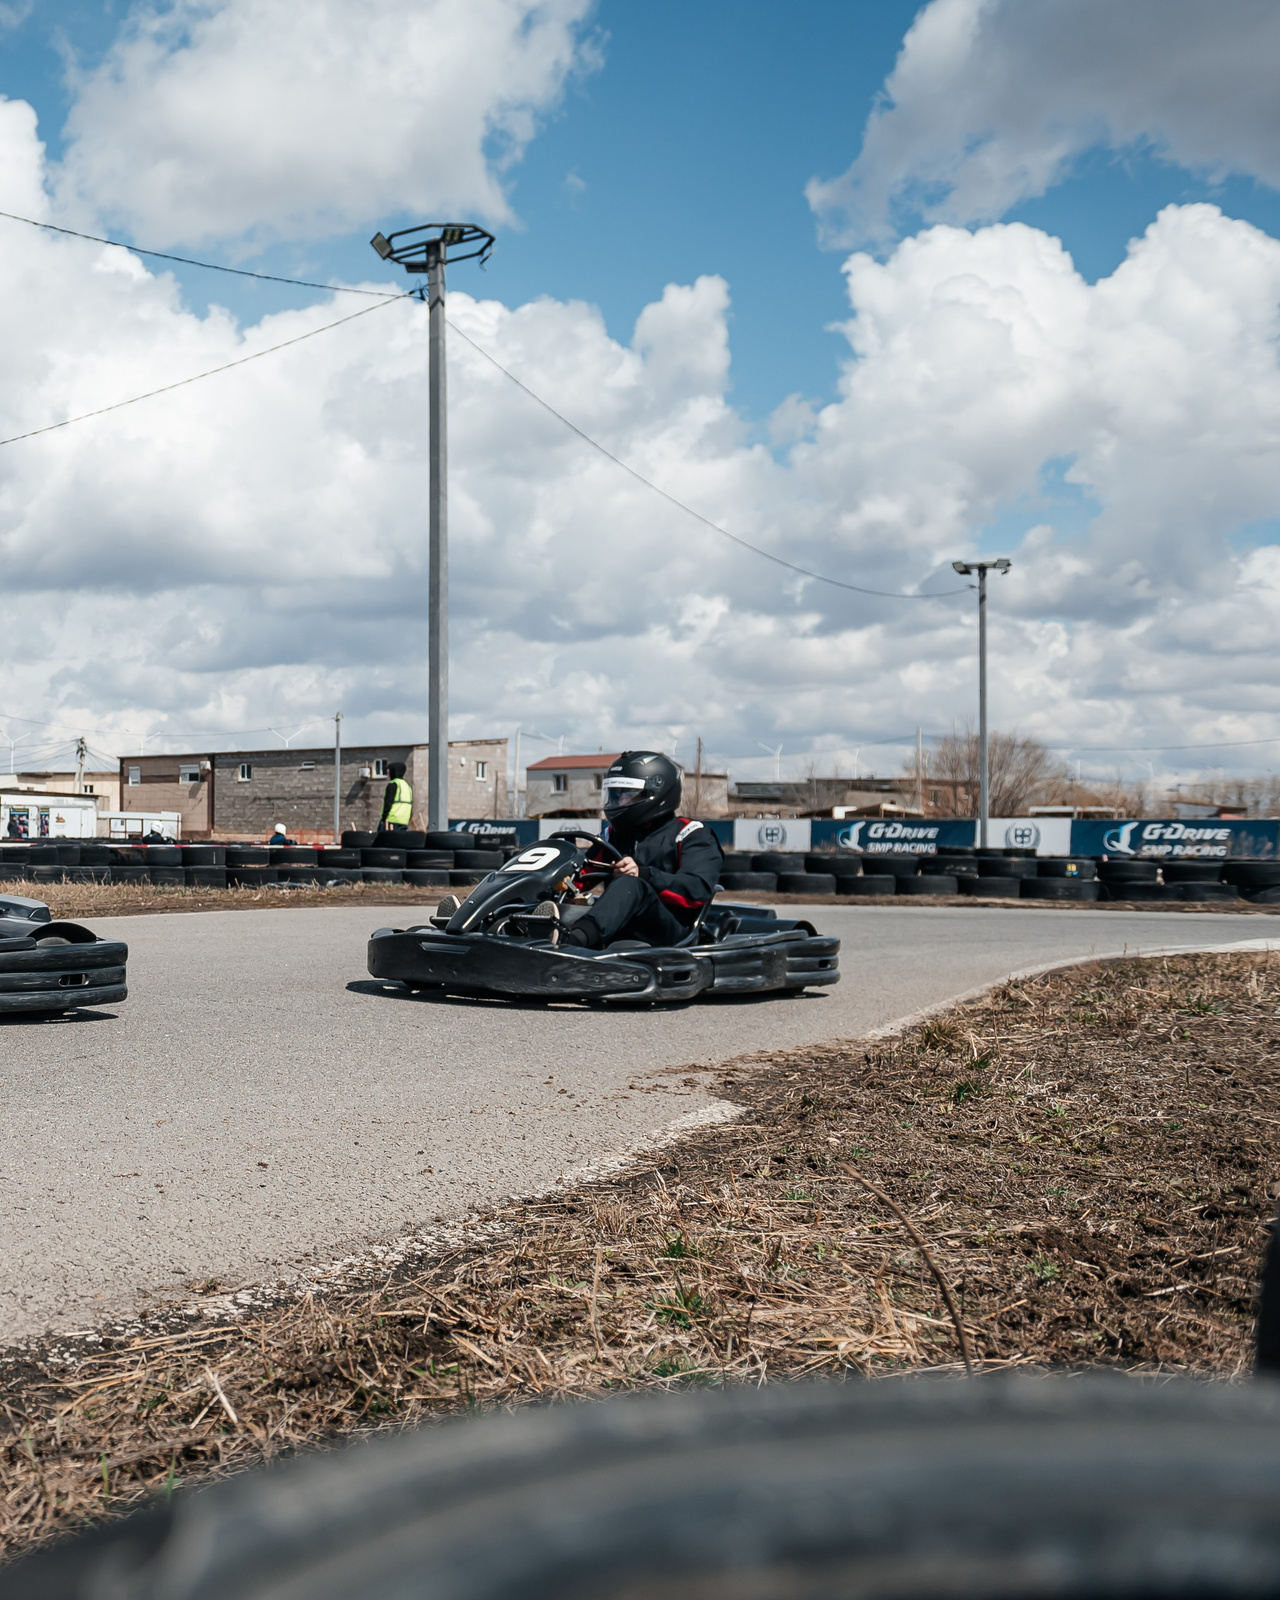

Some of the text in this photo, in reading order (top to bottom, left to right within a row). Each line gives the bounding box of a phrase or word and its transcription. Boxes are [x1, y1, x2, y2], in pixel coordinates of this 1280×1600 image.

[867, 842, 937, 854] SMP RACING
[1141, 845, 1227, 856] SMP RACING
[504, 847, 560, 871] 9
